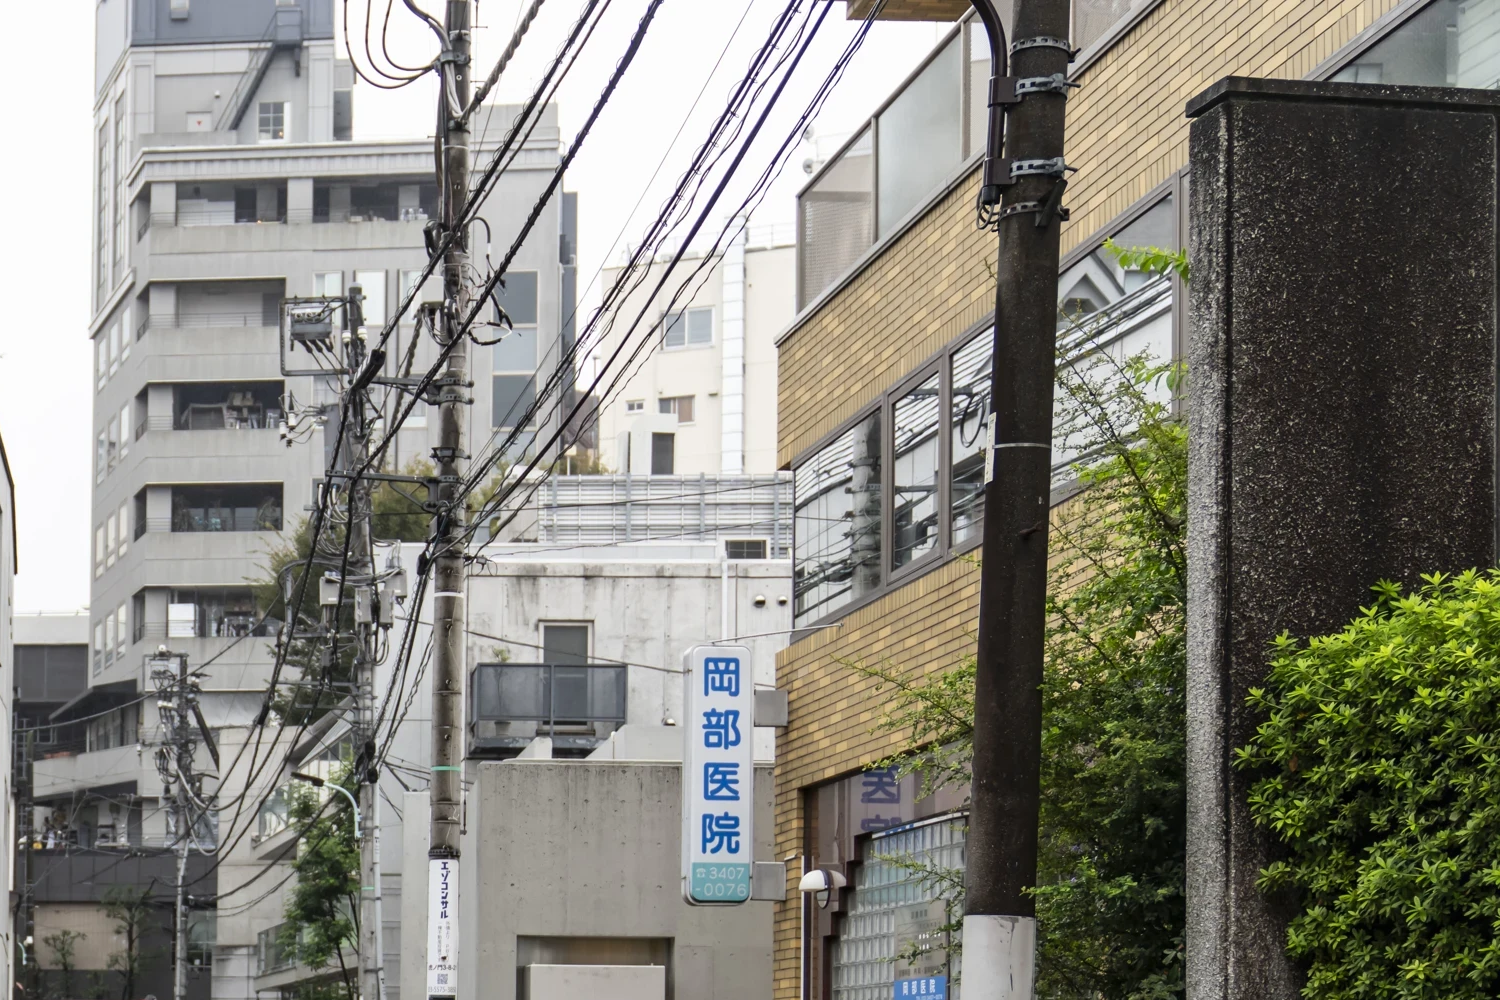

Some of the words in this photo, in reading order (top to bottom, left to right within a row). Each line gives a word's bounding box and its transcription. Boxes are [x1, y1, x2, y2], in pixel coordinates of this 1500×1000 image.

[701, 657, 741, 854] 岡部医院
[440, 861, 451, 919] エゾコンサル
[695, 883, 747, 896] -0076
[709, 867, 745, 879] 3407
